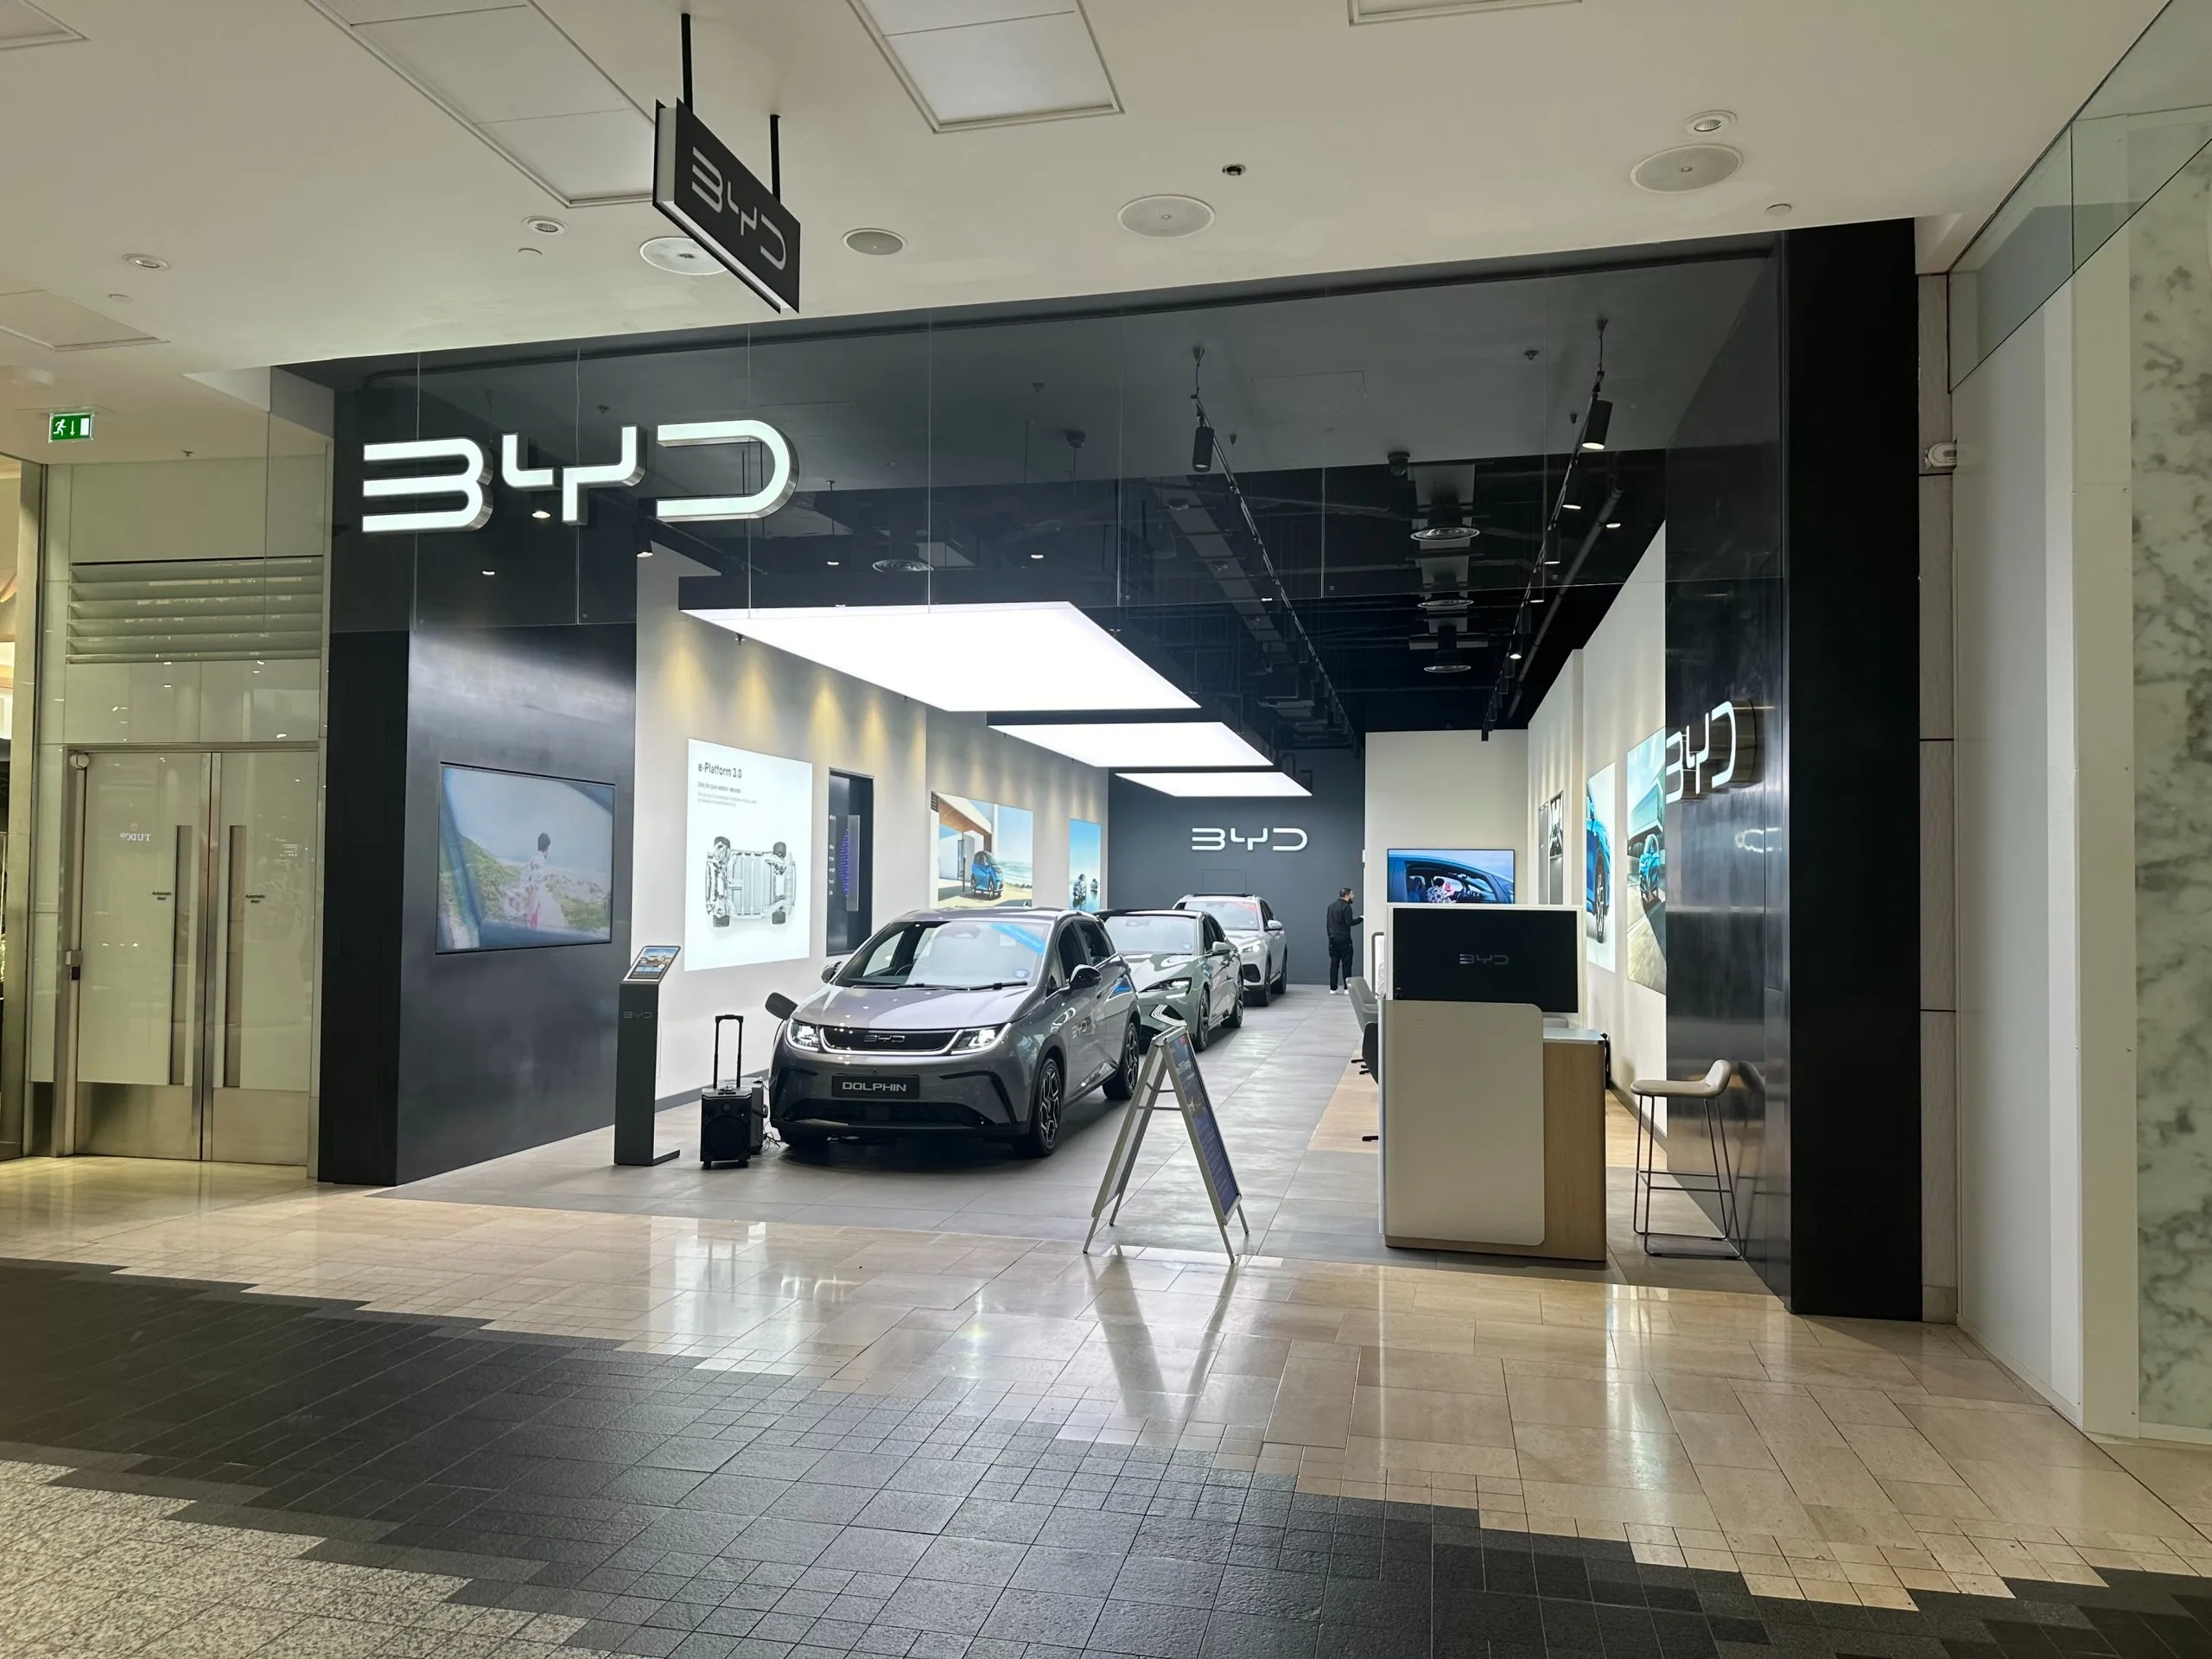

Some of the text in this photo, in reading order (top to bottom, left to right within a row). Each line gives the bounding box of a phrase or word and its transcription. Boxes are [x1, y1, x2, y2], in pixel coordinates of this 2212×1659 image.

[691, 146, 787, 270] BYD
[362, 419, 797, 532] BYD
[1665, 701, 1737, 804] BYD
[698, 762, 742, 779] e-Platform 3.0
[1192, 828, 1308, 851] BYD
[1459, 954, 1510, 964] BYD
[864, 1034, 906, 1043] BYD
[842, 1081, 906, 1092] DOLPHIN
